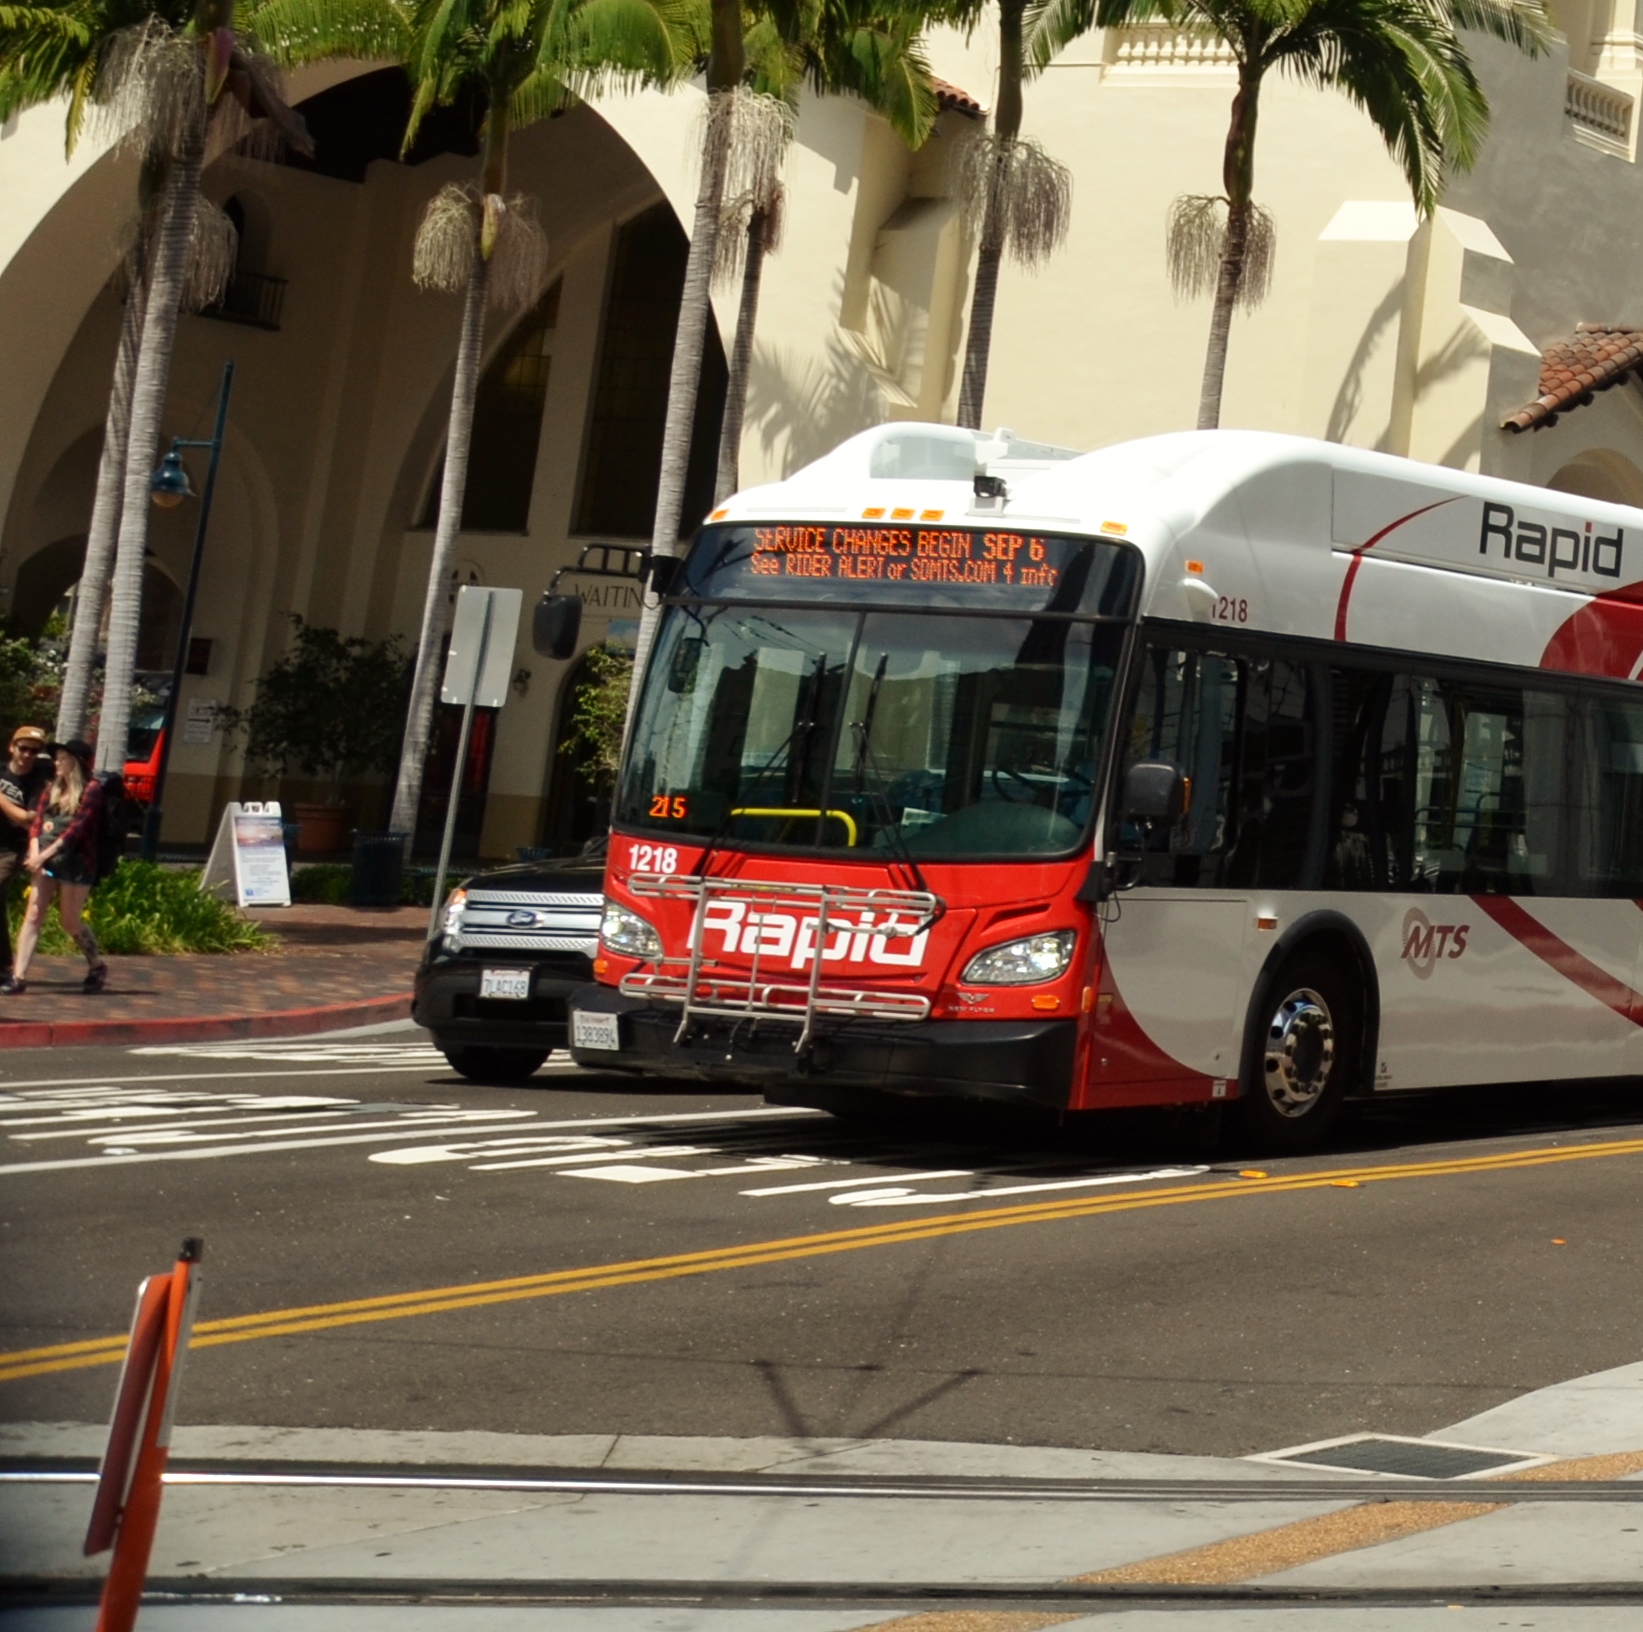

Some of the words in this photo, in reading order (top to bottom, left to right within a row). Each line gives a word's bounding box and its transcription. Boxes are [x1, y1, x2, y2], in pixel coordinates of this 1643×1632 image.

[753, 526, 827, 553] SERVICE
[832, 528, 912, 556] CHANGES
[916, 531, 972, 559] BEGIN
[982, 533, 1024, 561] SEP
[1028, 537, 1046, 562] 6
[1479, 501, 1624, 579] Rapid
[750, 551, 781, 575] See
[785, 553, 833, 578] RIDER
[837, 555, 886, 580] ALERT
[887, 562, 908, 581] or
[1002, 561, 1014, 585] 4
[1212, 595, 1248, 623] 1218
[649, 795, 686, 818] 215
[629, 844, 677, 874] 1218
[686, 900, 930, 970] Rapid
[1400, 924, 1470, 959] MTS
